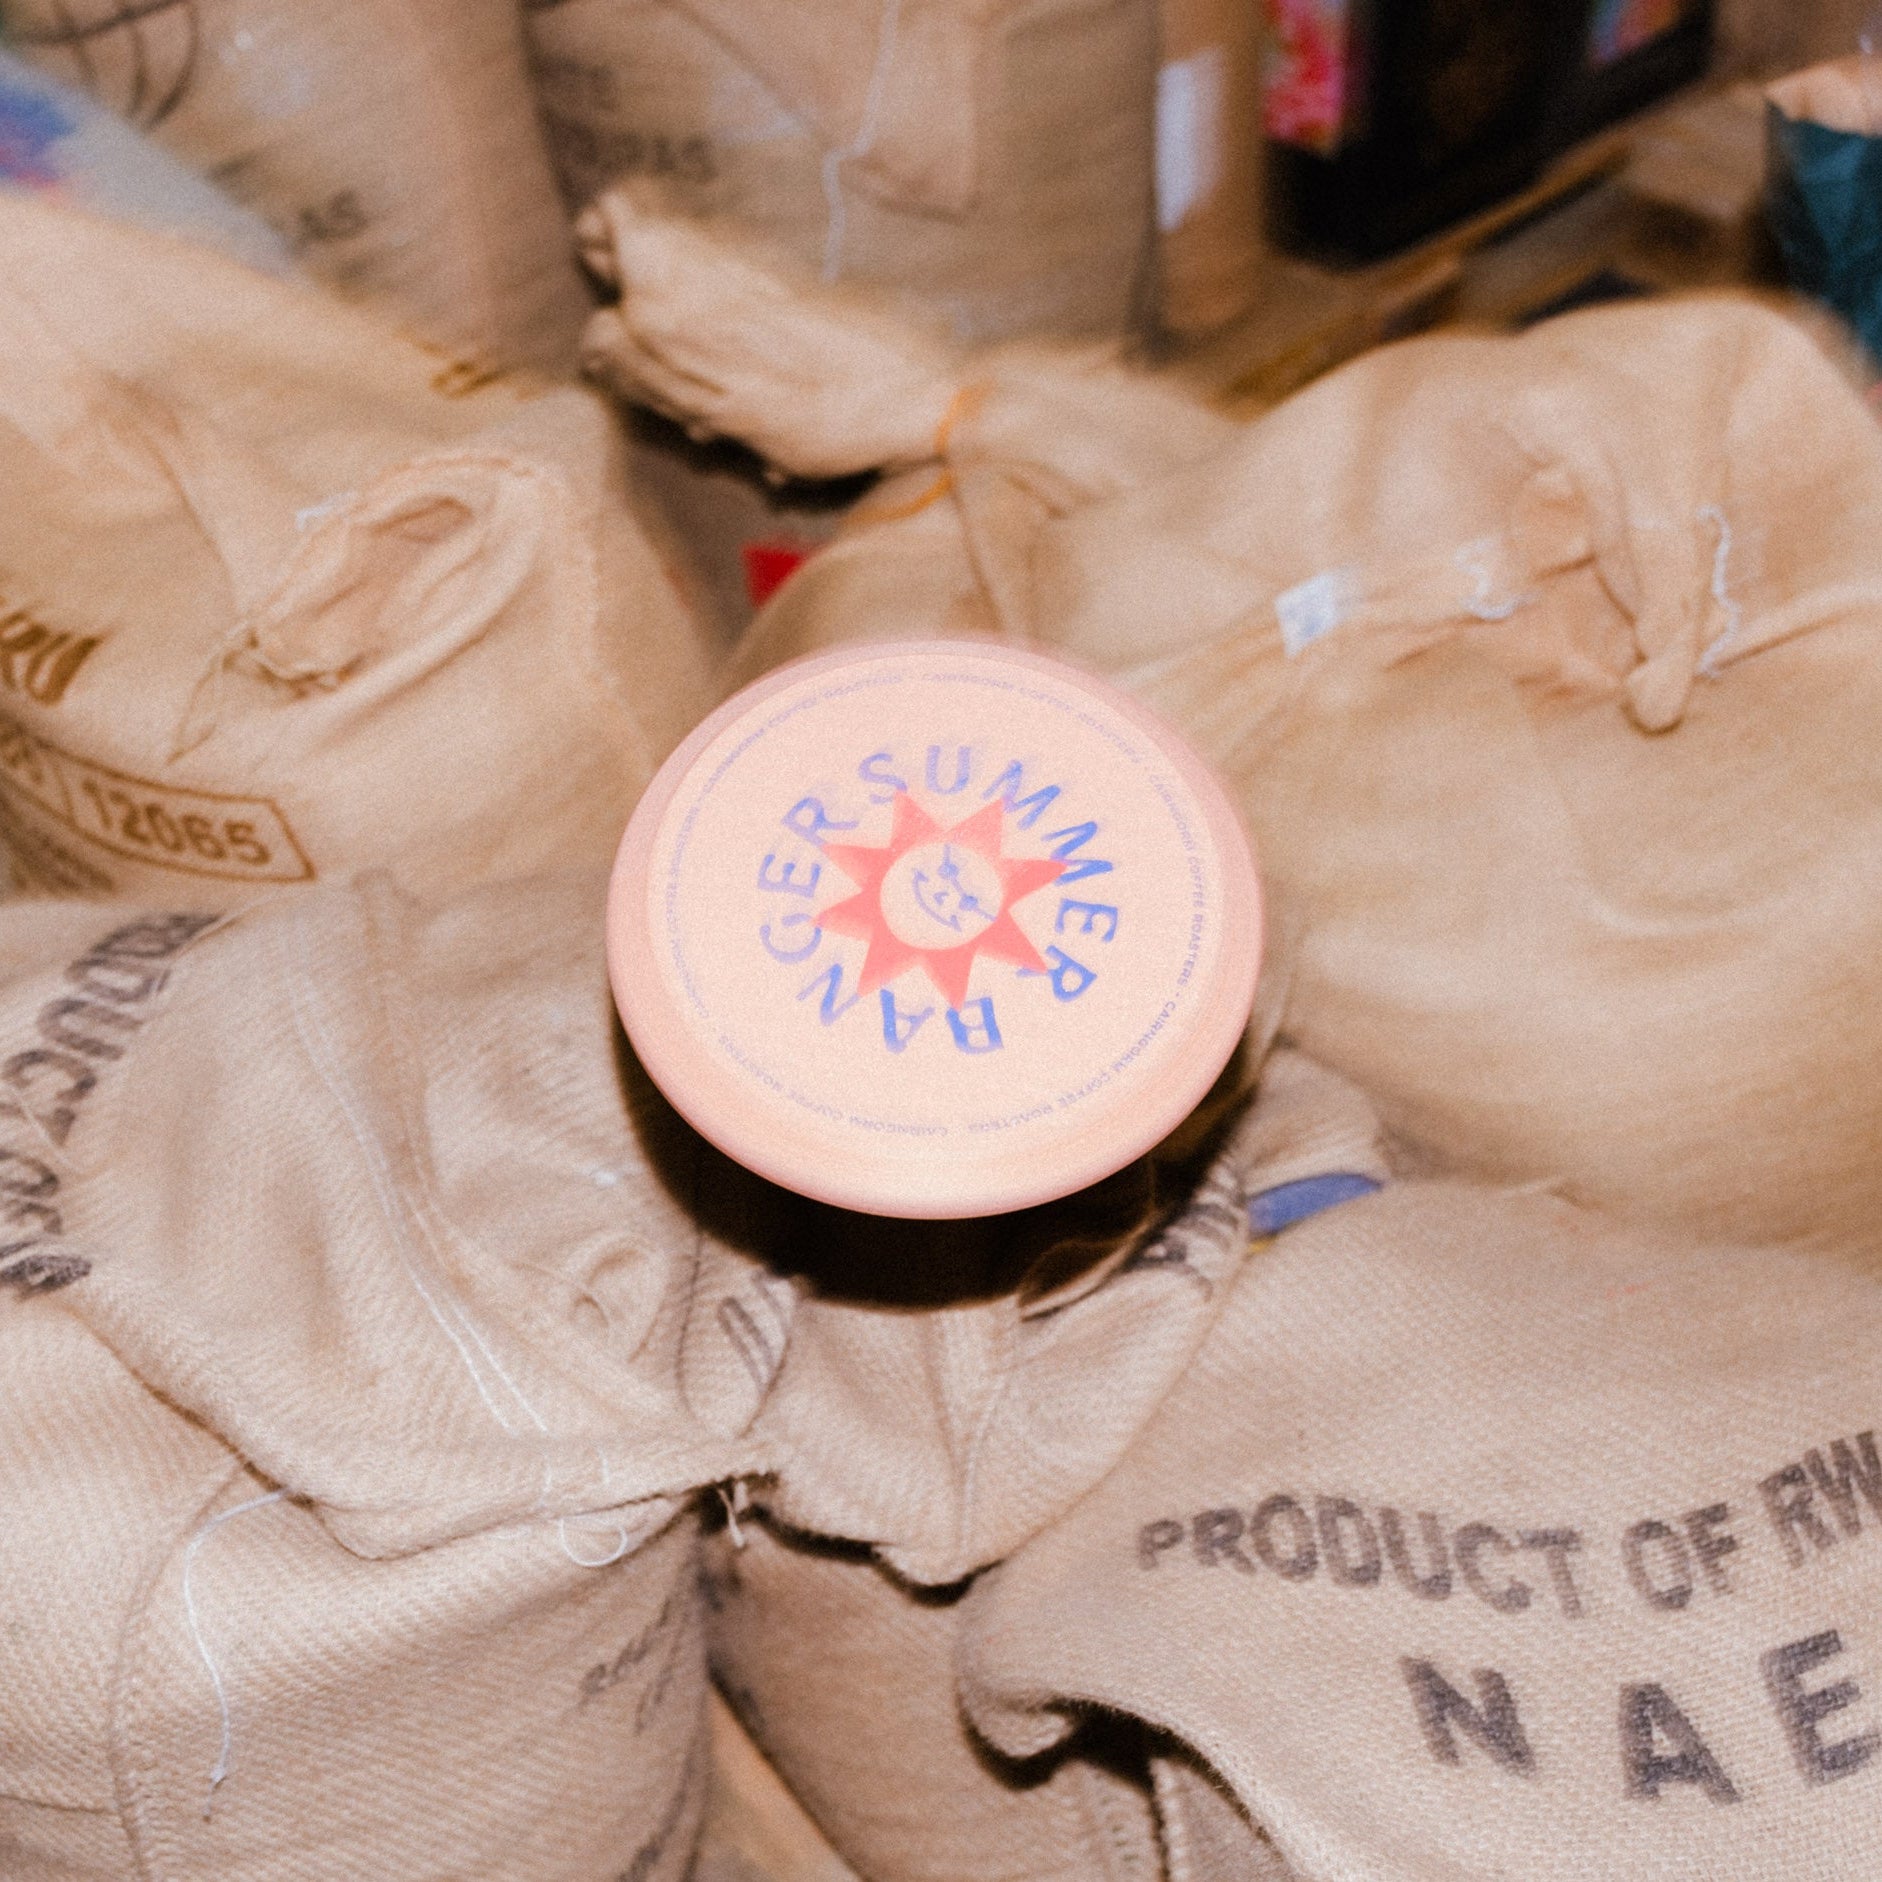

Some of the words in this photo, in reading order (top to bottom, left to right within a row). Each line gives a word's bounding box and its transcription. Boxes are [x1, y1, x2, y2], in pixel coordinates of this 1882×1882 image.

[81, 775, 272, 867] 12065
[1147, 771, 1197, 851] CAIRNGORM
[857, 744, 1118, 1002] SUMMER
[1187, 855, 1205, 908] COFFEE
[757, 796, 1004, 1055] BANGER
[1175, 913, 1204, 987] ROASTERS
[1110, 999, 1178, 1074] CAIRNGORM
[967, 1102, 1054, 1134] ROASTERS
[1056, 1070, 1114, 1109] COFFEE
[1135, 1494, 1585, 1620] PRODUCT
[1622, 1502, 1742, 1611] OF
